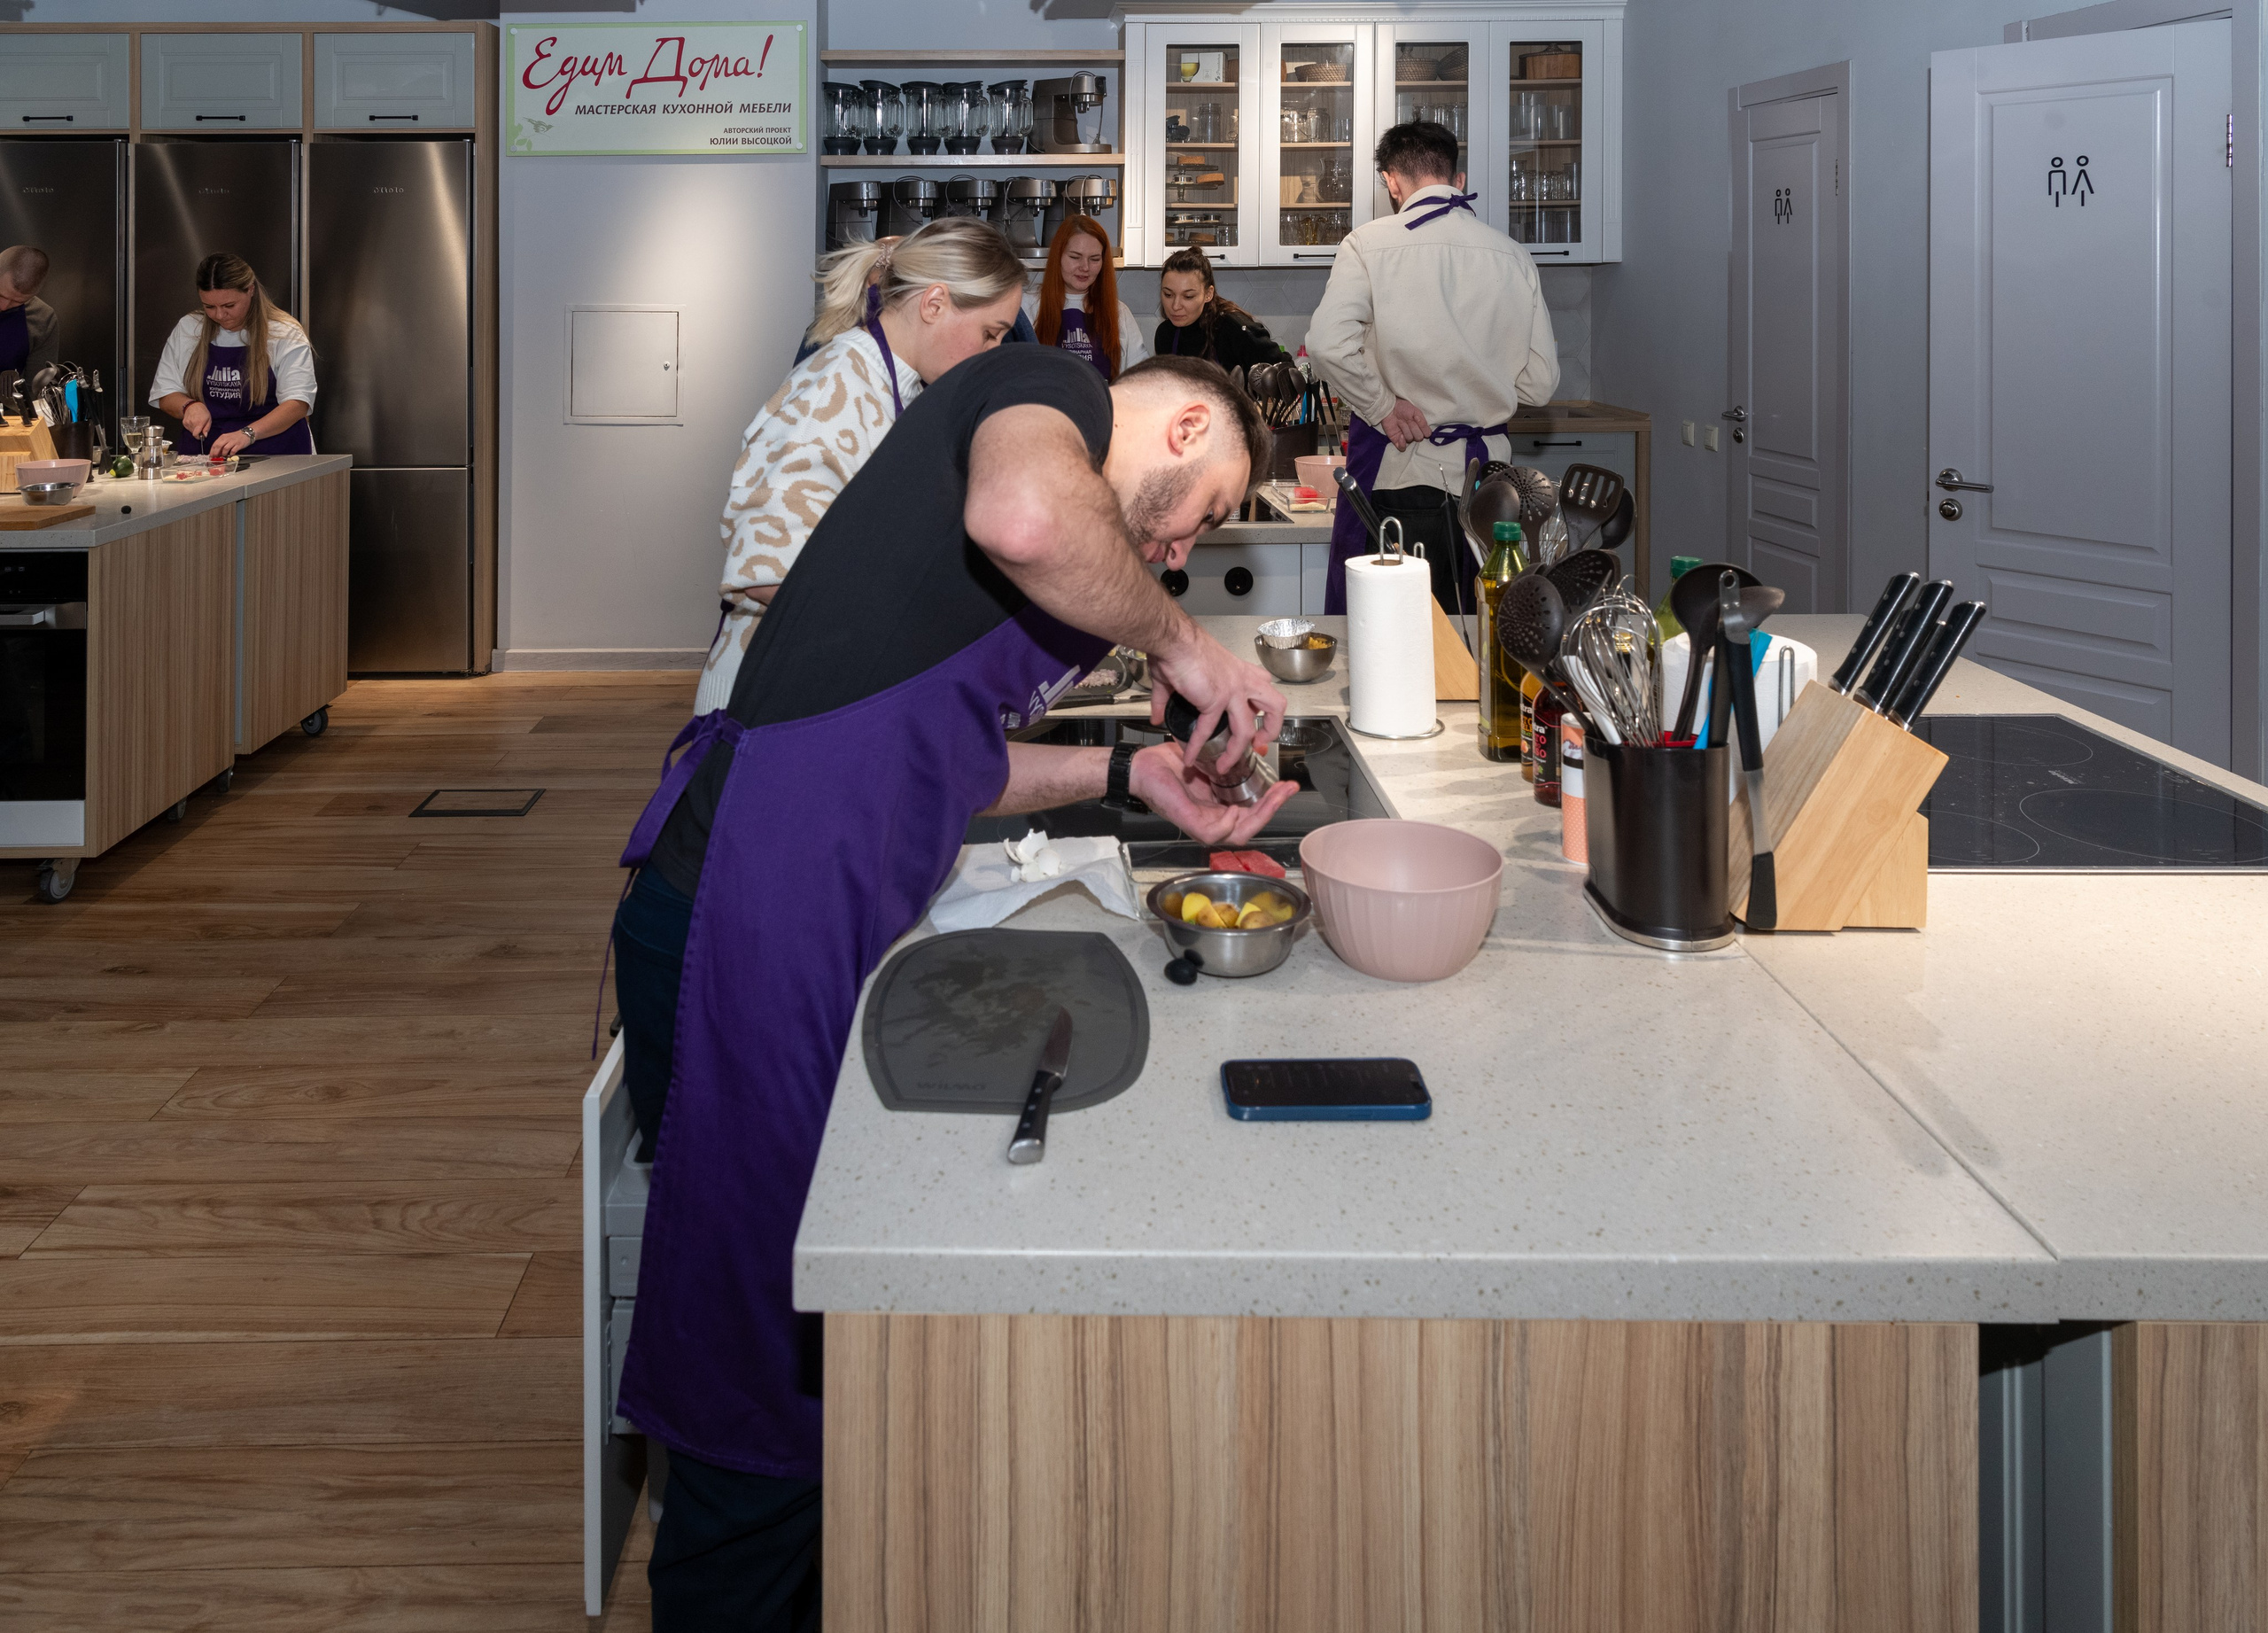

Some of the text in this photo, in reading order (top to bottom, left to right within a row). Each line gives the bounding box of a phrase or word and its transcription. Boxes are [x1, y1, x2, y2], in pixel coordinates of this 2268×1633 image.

[522, 34, 774, 116] Едим Дома!
[574, 101, 792, 115] МАСТЕРСКАЯ КУХОННОЙ МЕБЕЛИ
[741, 136, 792, 146] ВЫСОЦКОЙ
[206, 365, 240, 381] Julia
[209, 391, 241, 400] СТУДИЯ
